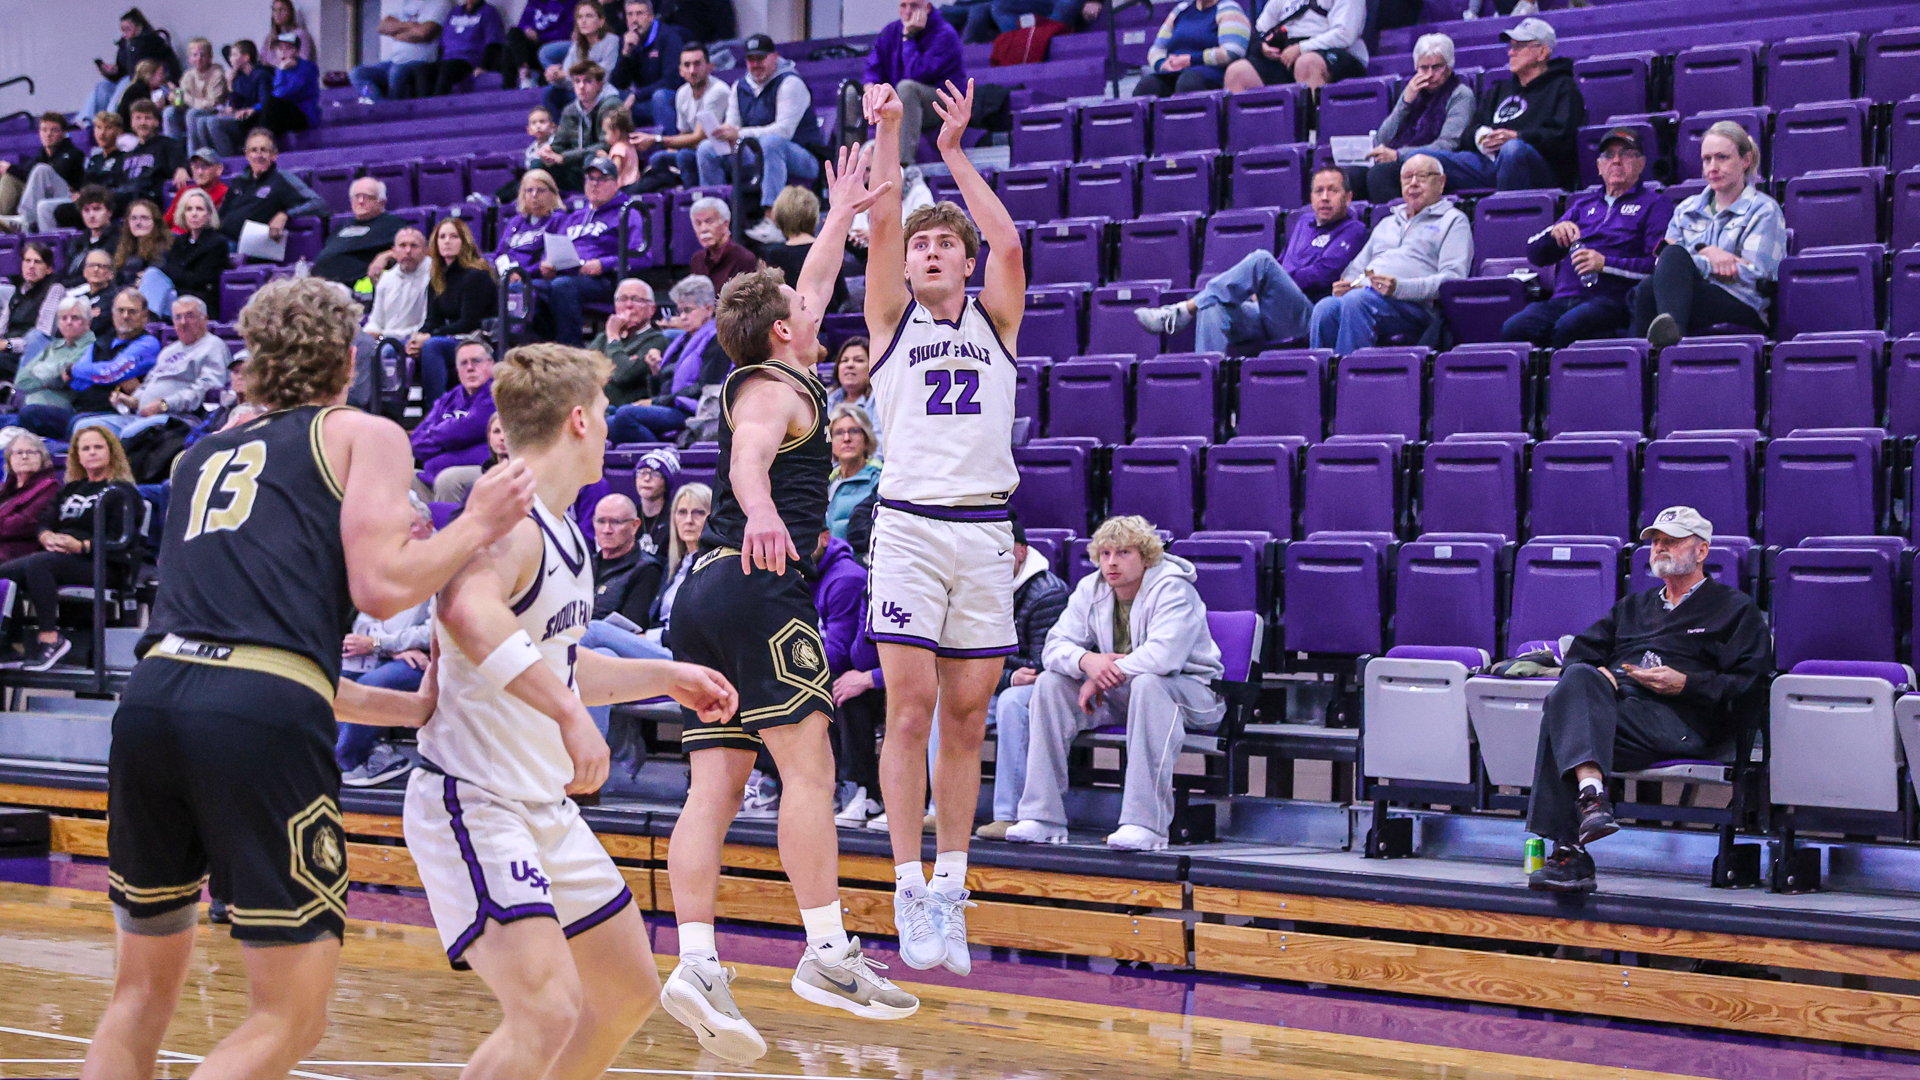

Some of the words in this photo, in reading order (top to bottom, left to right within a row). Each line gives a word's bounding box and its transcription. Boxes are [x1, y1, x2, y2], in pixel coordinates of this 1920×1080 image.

[909, 340, 952, 368] SIOUX
[953, 341, 992, 366] FALLS
[925, 369, 981, 415] 22
[184, 440, 267, 541] 13
[881, 601, 912, 628] USF
[510, 860, 550, 895] USF
